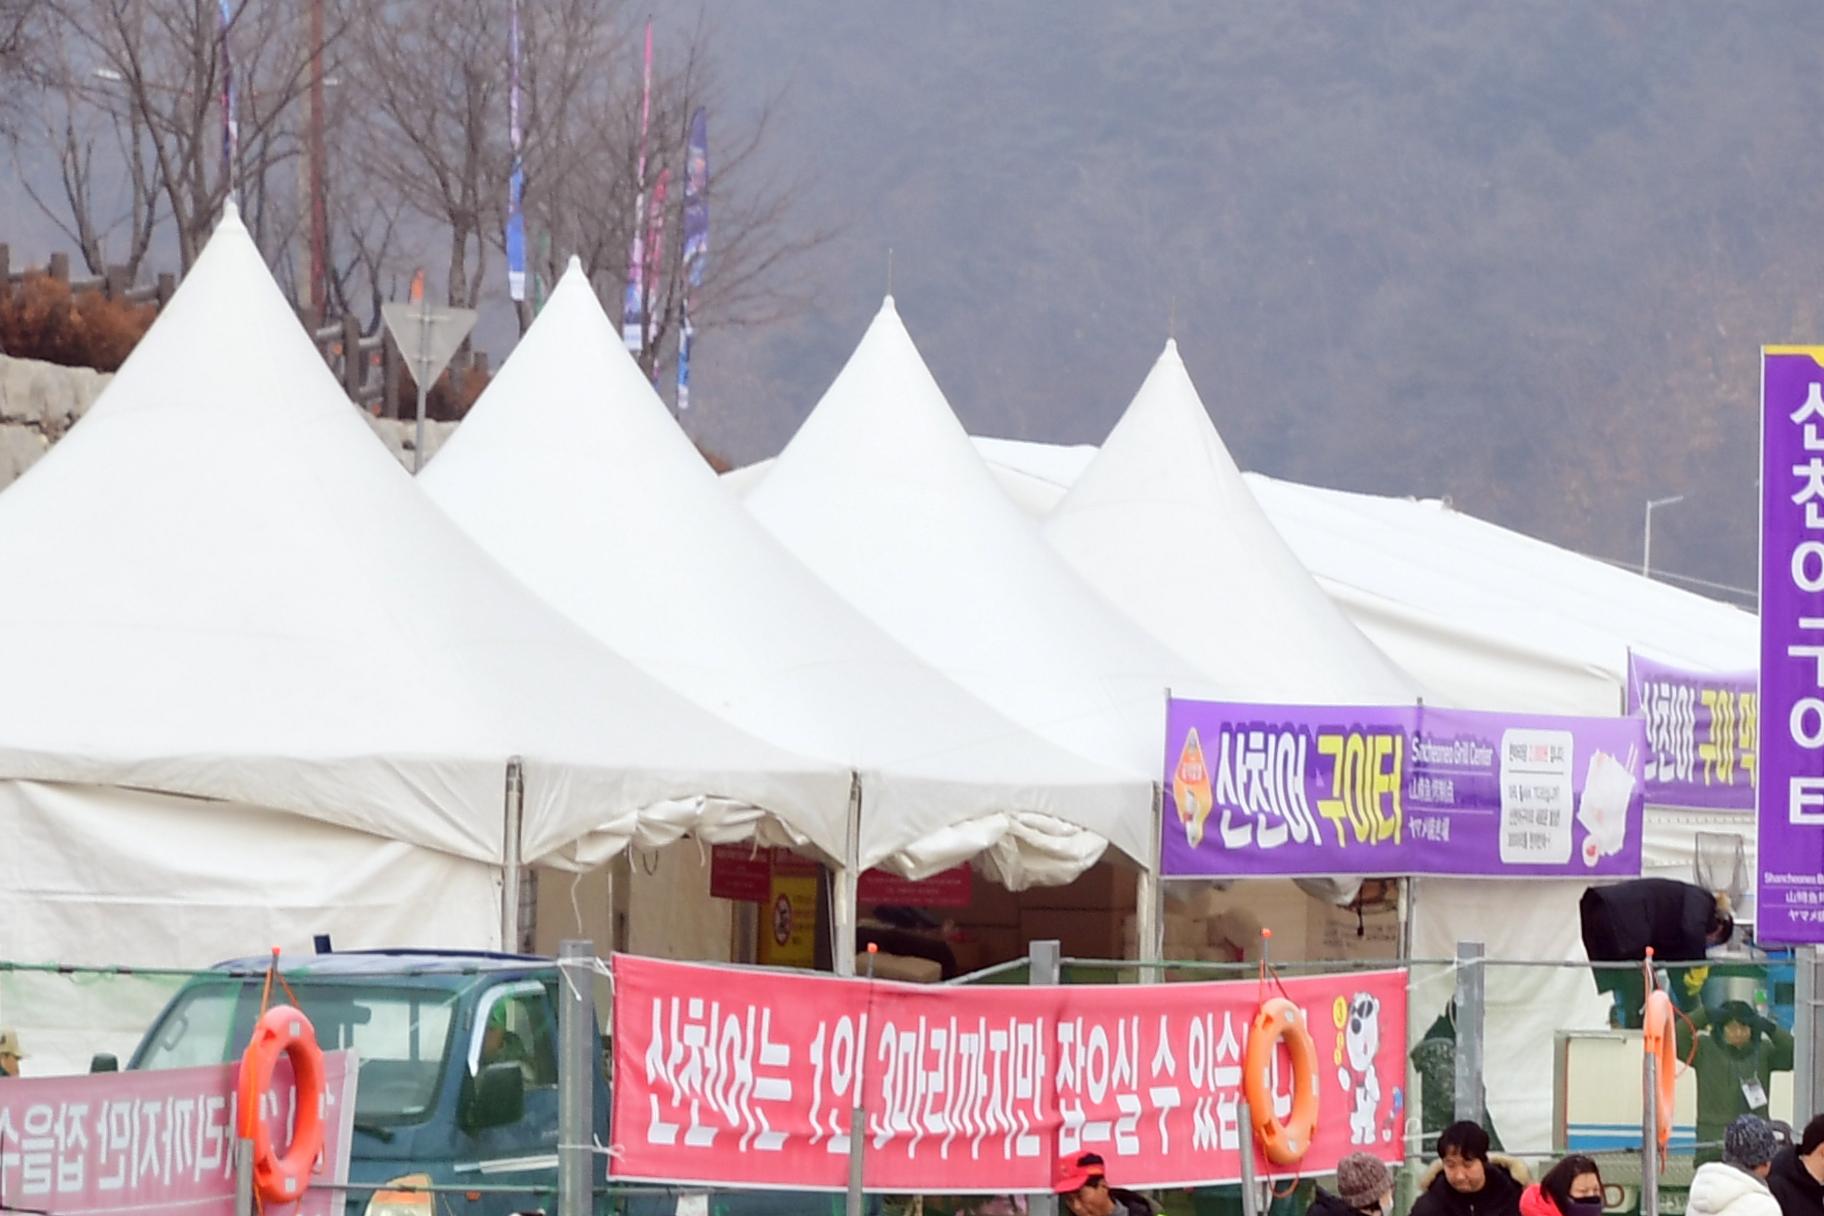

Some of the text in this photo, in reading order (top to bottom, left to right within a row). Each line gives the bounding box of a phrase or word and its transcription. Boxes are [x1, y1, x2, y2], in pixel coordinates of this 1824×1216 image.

[1216, 731, 1404, 848] 산천어 구이터
[1643, 682, 1696, 783] 산천어
[1699, 689, 1734, 787] 구이
[645, 997, 1308, 1160] 산천어는 1인 3마리까지만 잡으실 수 있습다
